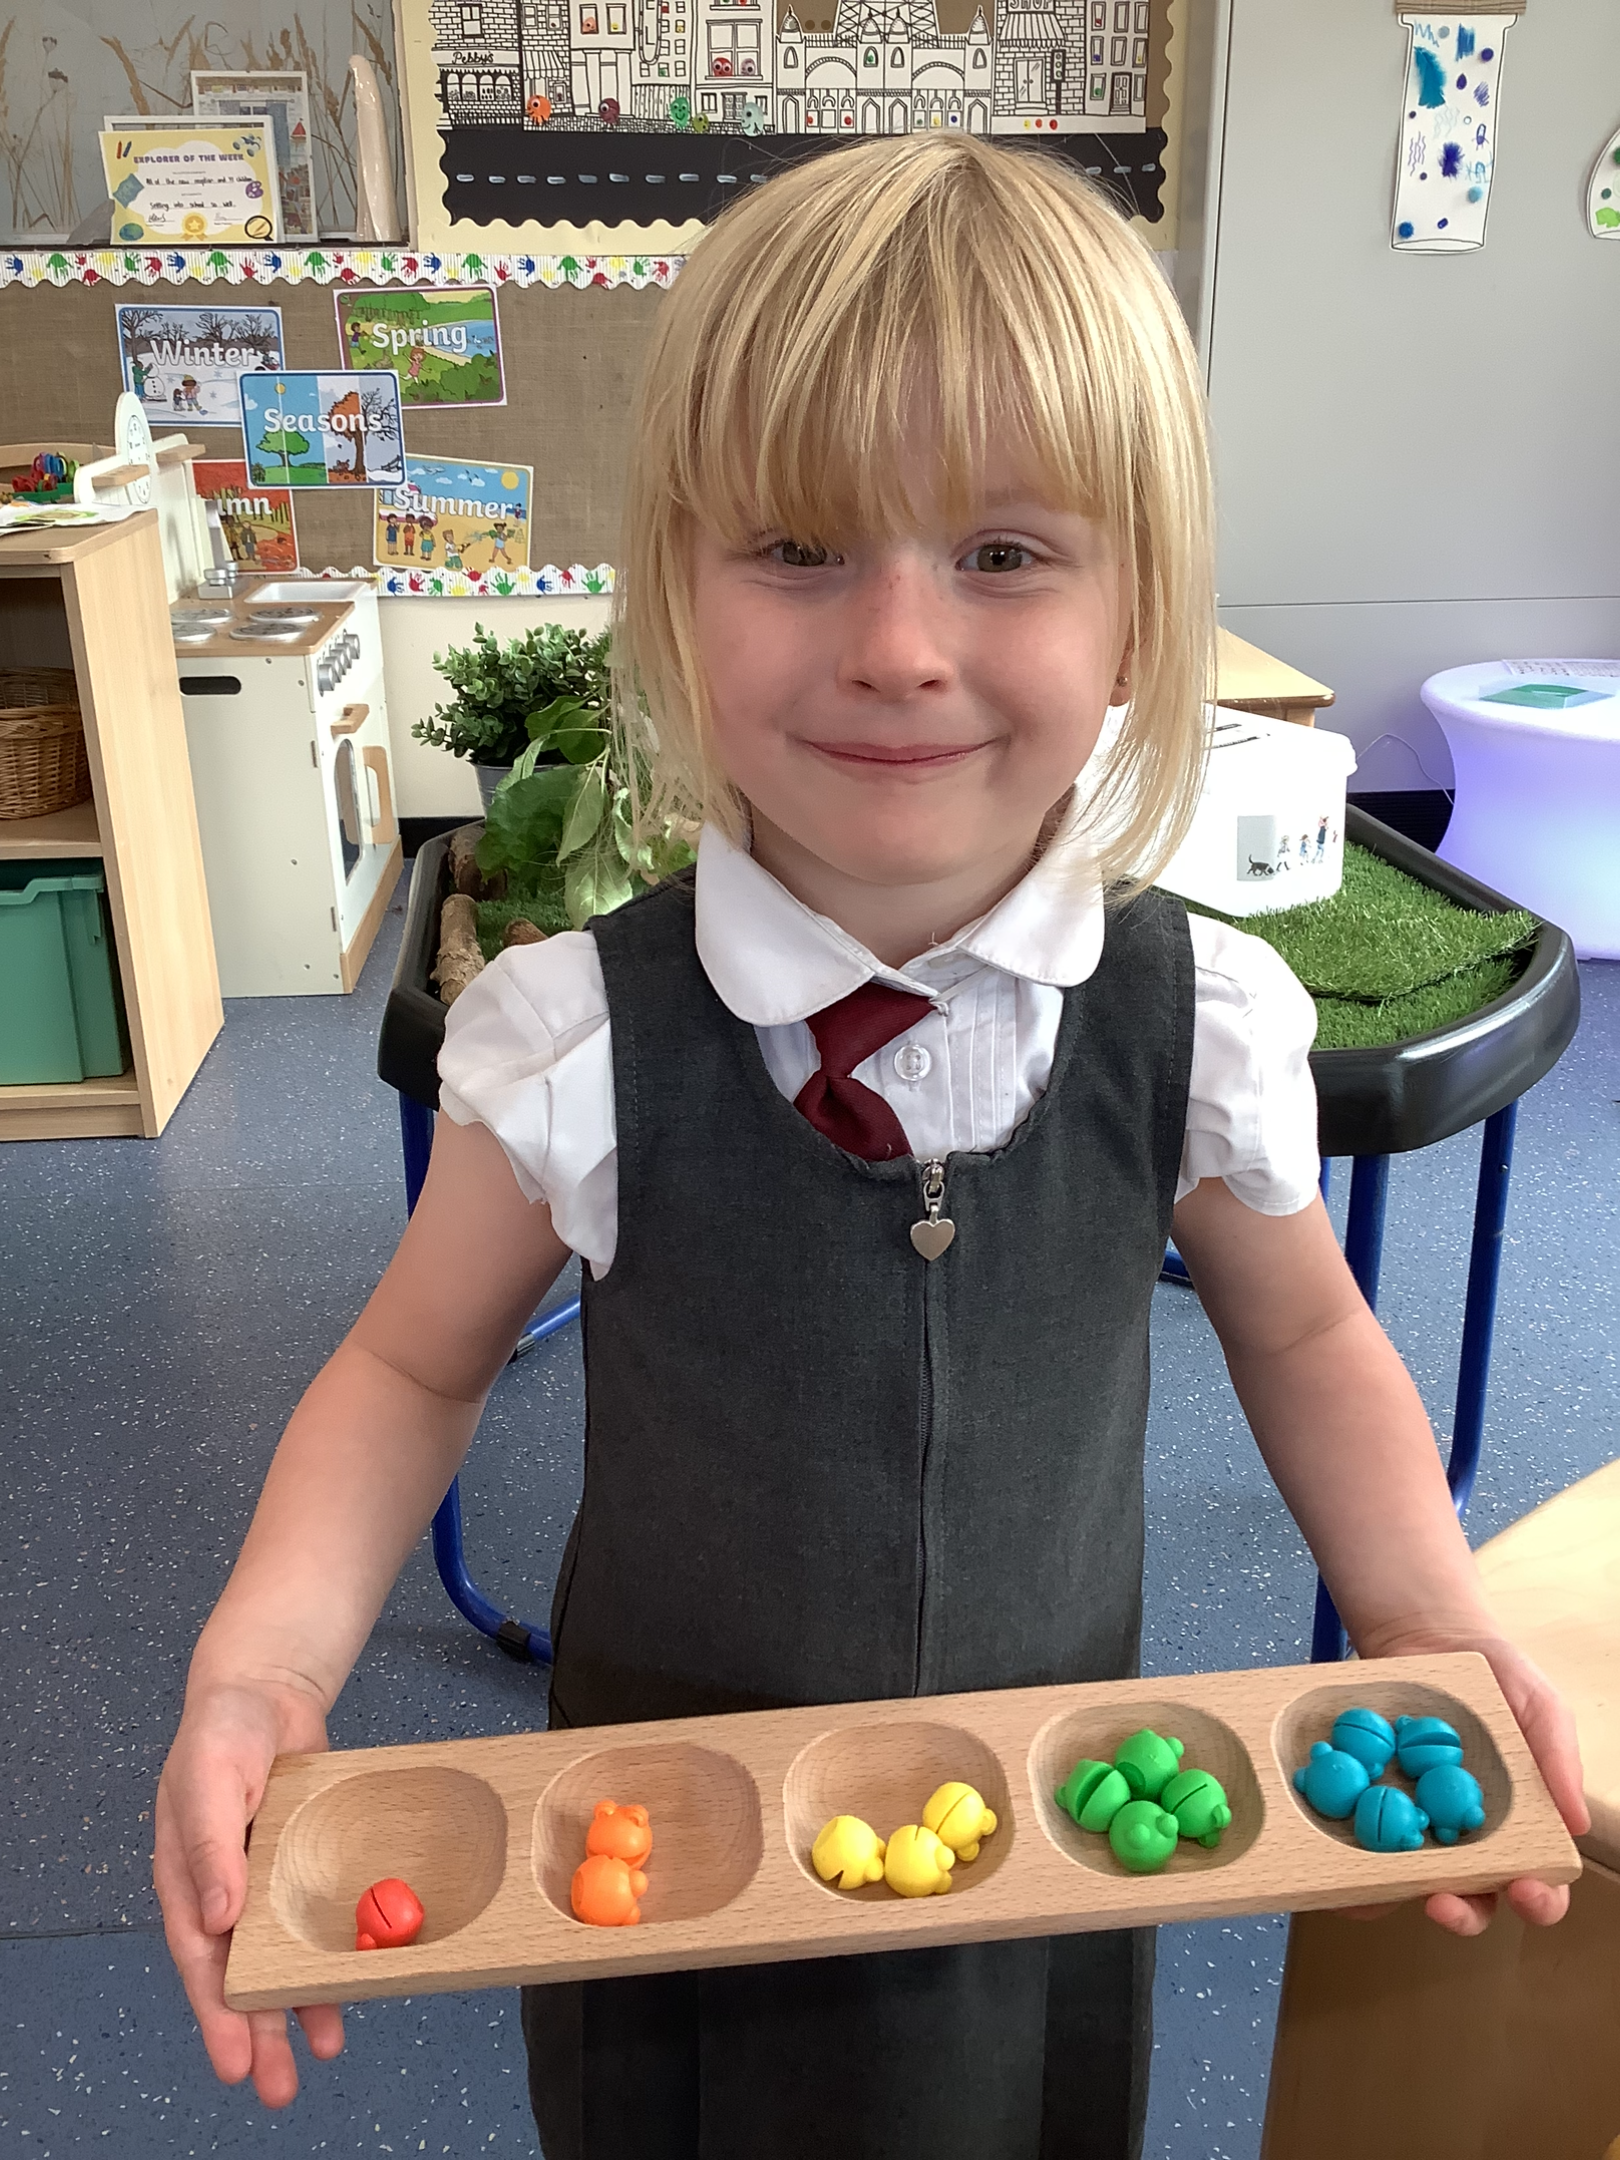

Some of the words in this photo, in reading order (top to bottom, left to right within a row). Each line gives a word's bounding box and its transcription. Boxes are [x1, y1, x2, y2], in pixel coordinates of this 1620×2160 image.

[1010, 0, 1052, 10] SHOP
[133, 155, 180, 164] EXPLORER
[183, 155, 195, 163] OF
[198, 154, 216, 162] THE
[218, 153, 244, 162] WEEK
[372, 319, 468, 355] Spring
[150, 339, 255, 367] Winter
[263, 407, 383, 433] Seasons
[393, 487, 513, 520] Summer
